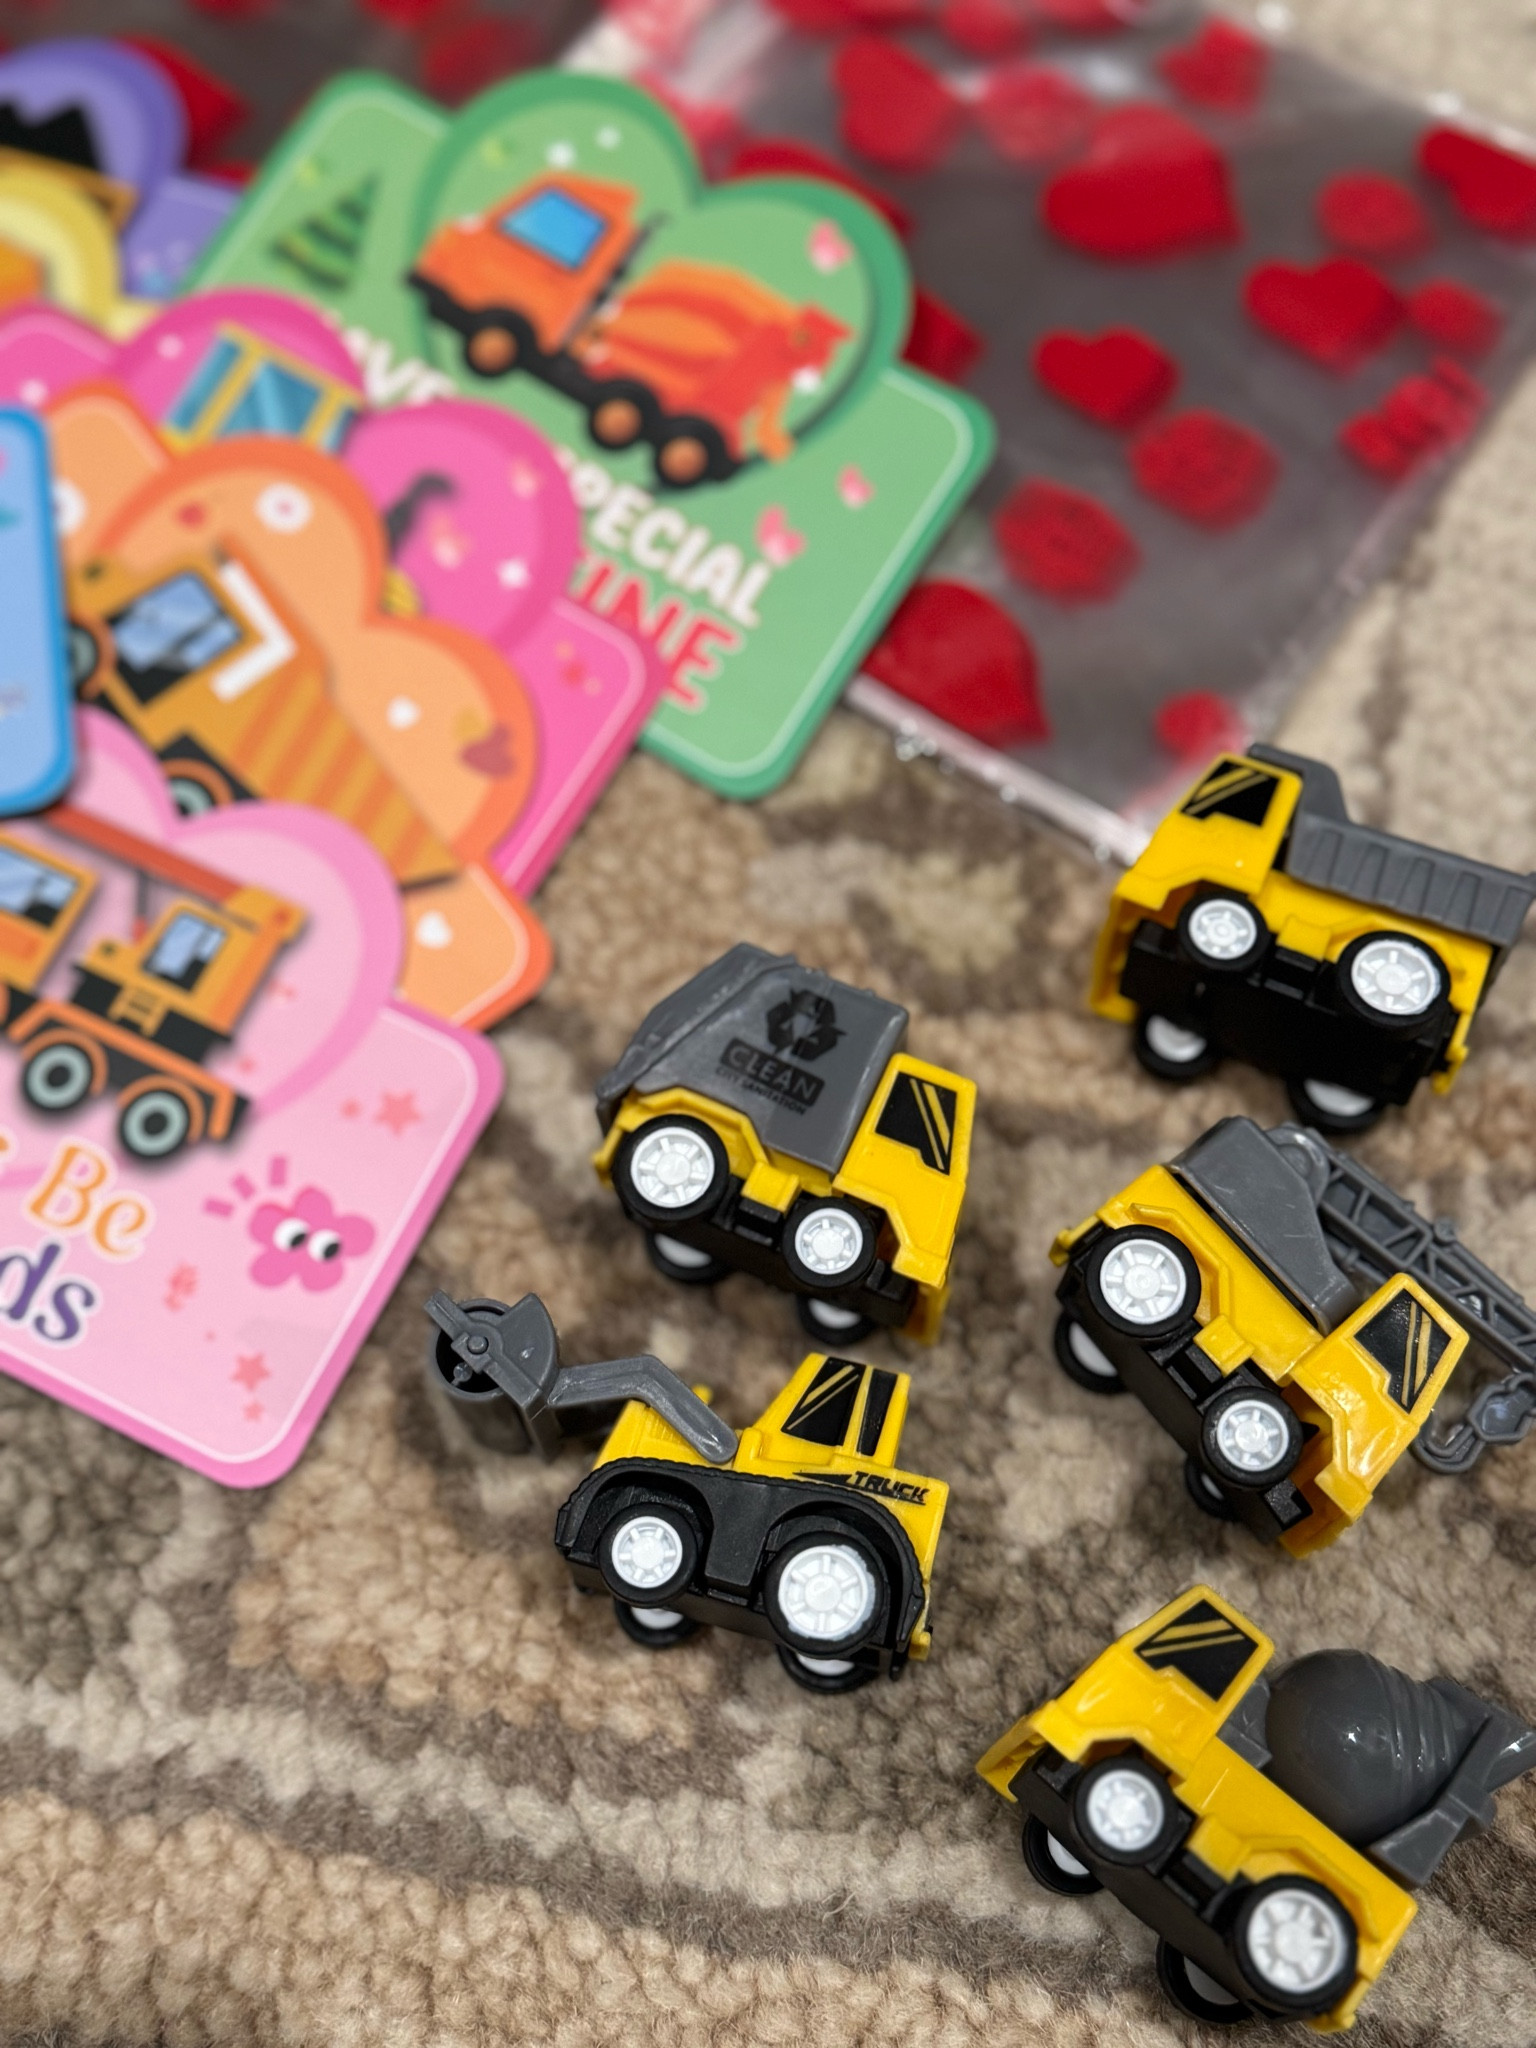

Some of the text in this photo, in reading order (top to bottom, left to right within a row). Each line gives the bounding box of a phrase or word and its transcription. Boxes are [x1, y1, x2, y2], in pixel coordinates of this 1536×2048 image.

[553, 447, 769, 629] PECIAL
[727, 1044, 819, 1101] CLEAN
[29, 1145, 148, 1256] Be
[854, 1470, 931, 1503] TRUCK
